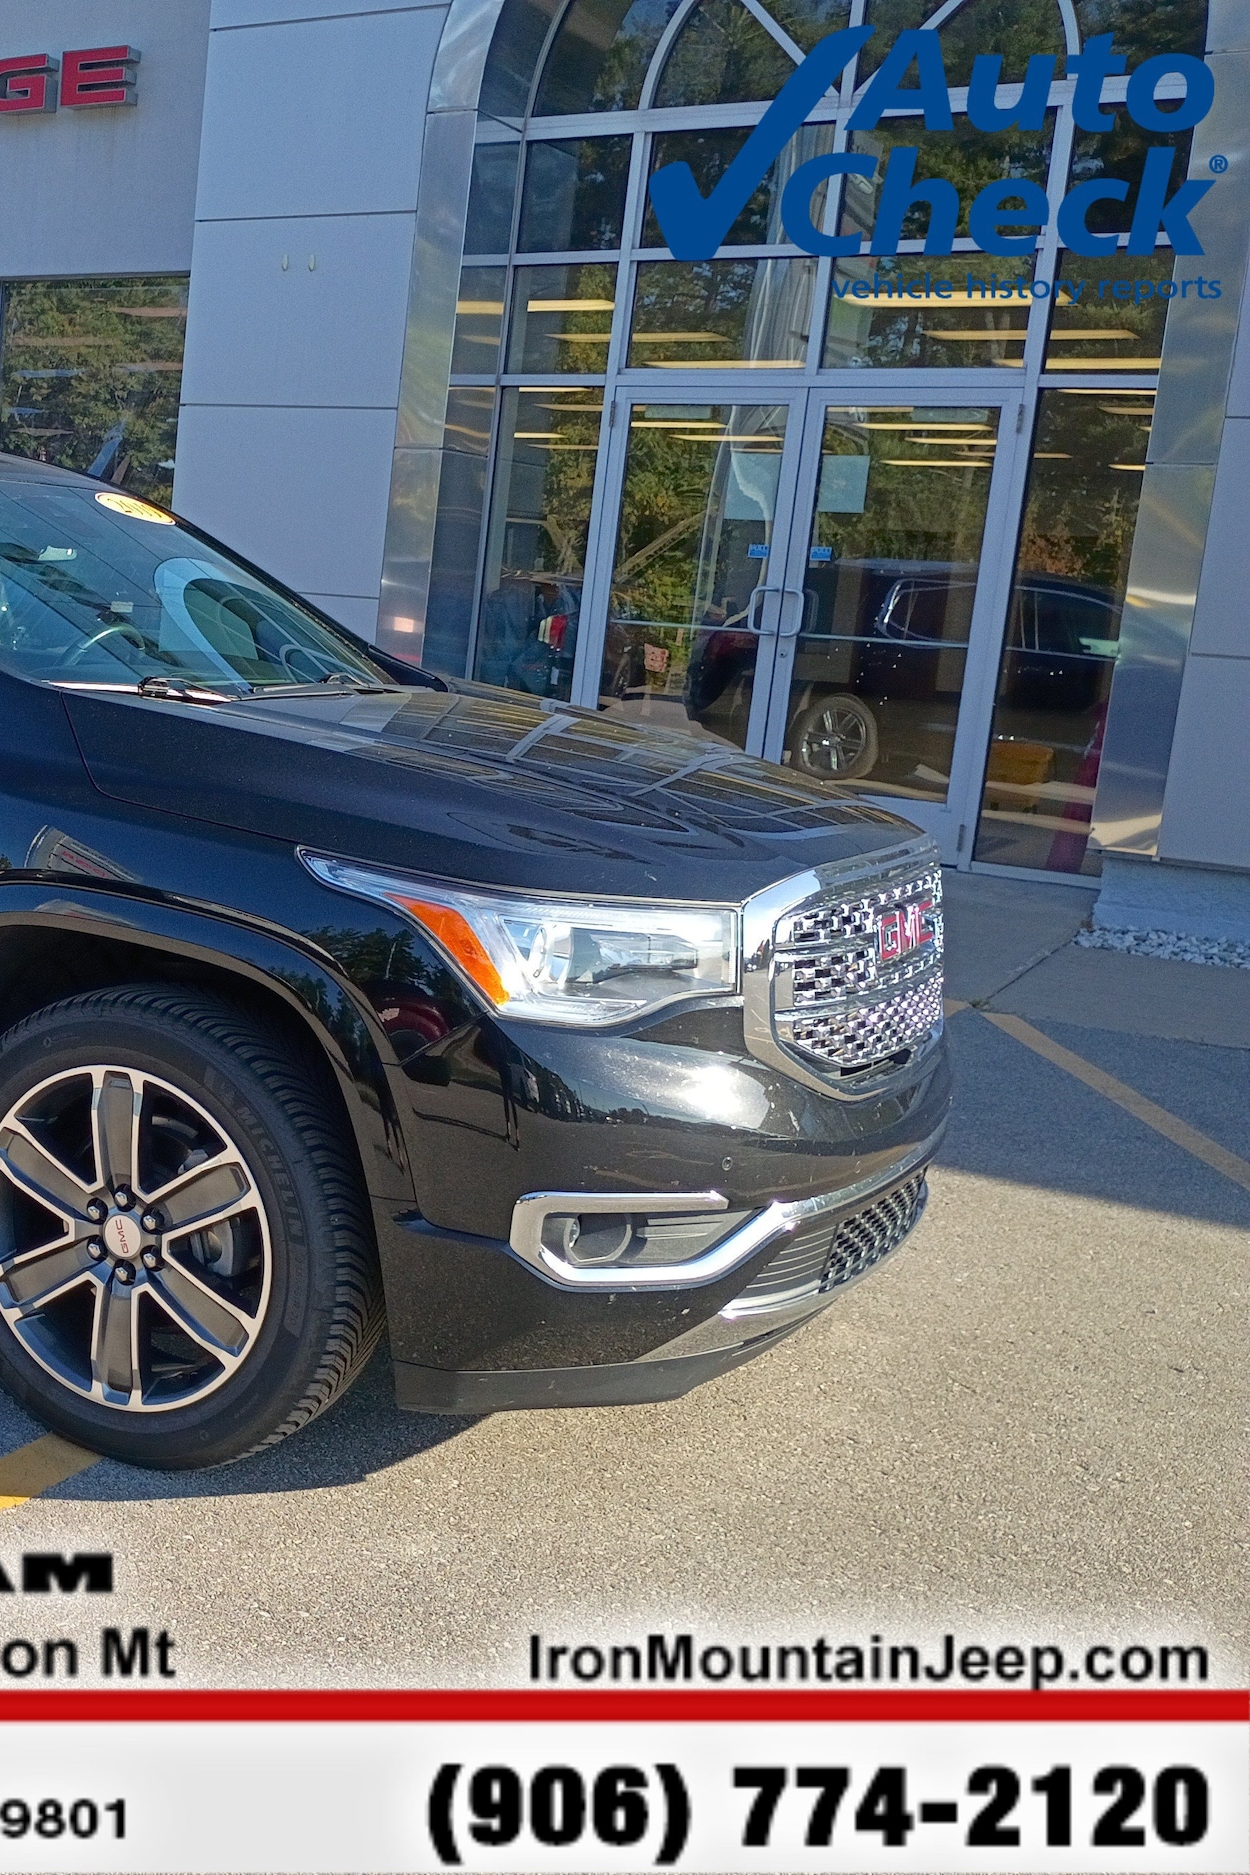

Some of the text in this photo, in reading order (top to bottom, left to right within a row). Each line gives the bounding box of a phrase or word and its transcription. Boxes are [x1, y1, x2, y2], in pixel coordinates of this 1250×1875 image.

[878, 900, 935, 961] GMC
[236, 1106, 305, 1241] MICHELIN
[115, 1219, 129, 1254] GMC
